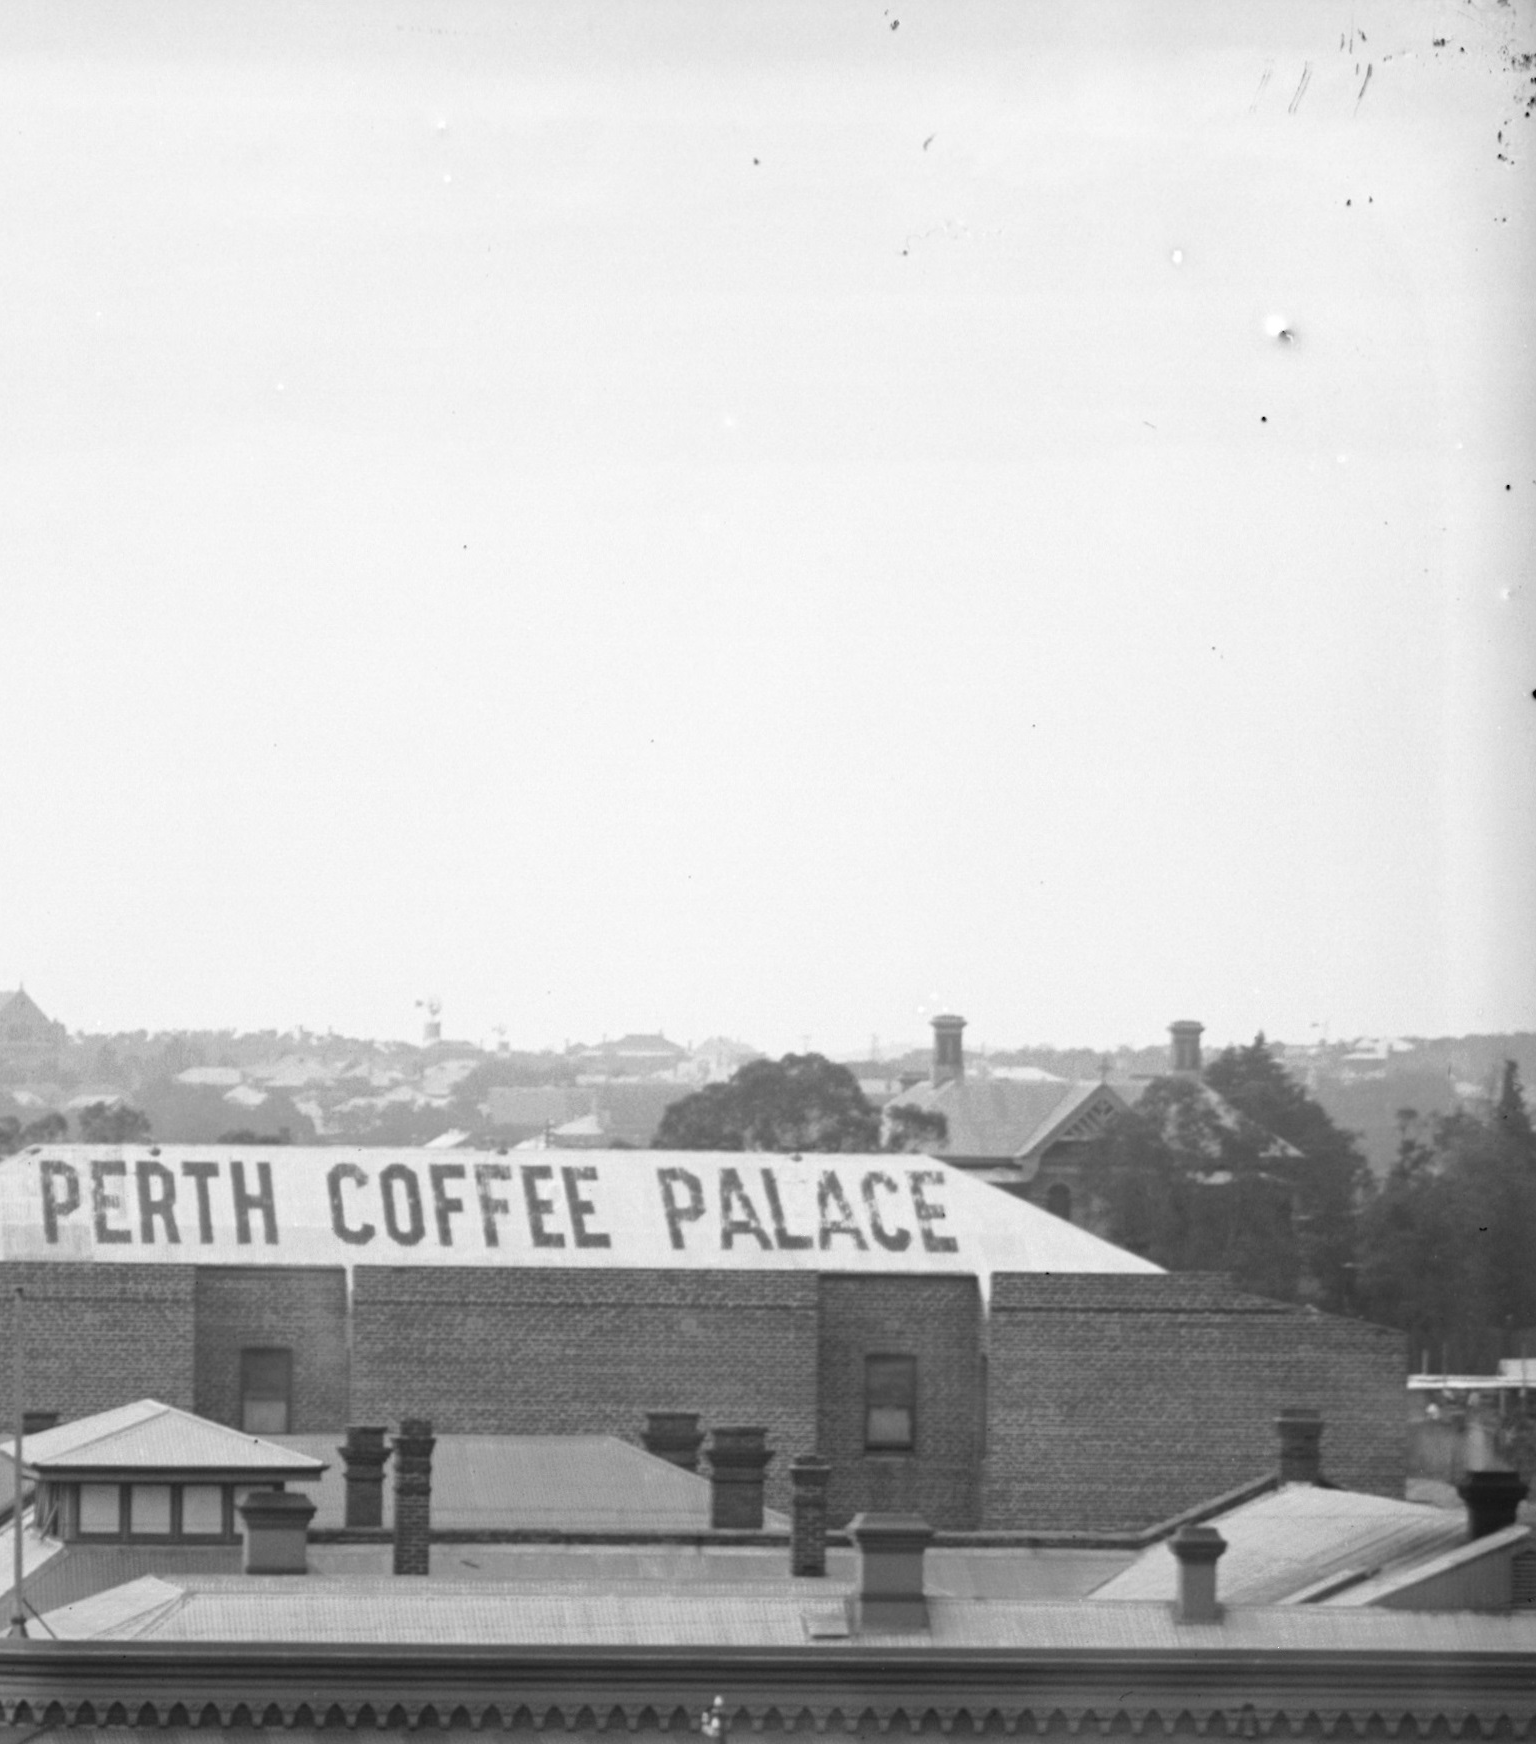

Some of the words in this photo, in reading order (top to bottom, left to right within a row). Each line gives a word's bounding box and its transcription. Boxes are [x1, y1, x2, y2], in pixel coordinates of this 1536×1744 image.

[39, 1159, 280, 1246] PERTH
[326, 1162, 612, 1249] COFFEE
[657, 1165, 962, 1253] PALACE
